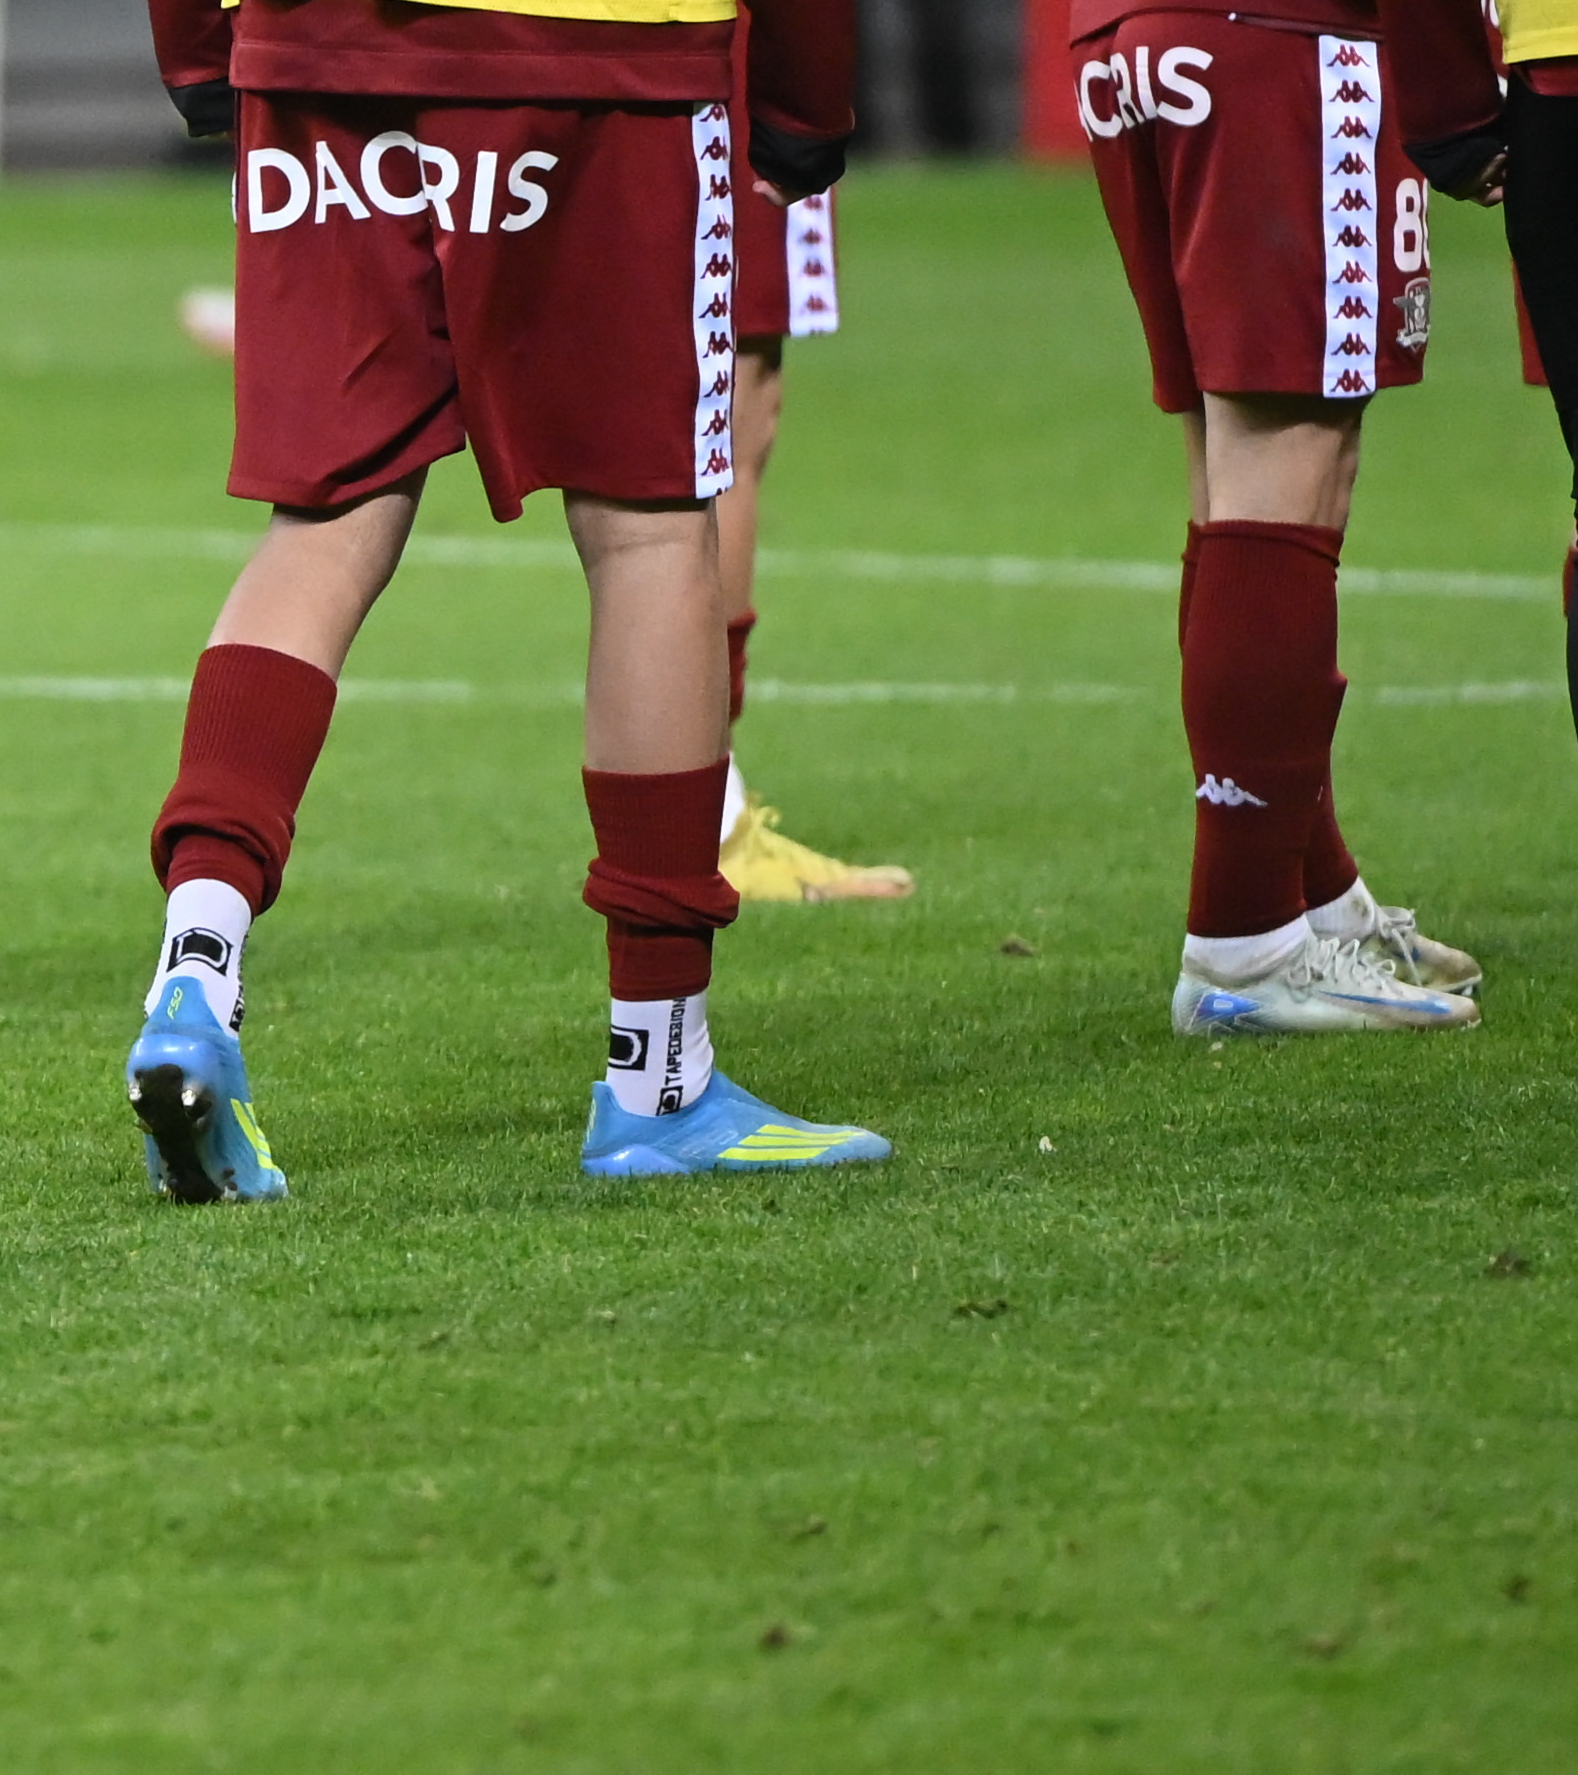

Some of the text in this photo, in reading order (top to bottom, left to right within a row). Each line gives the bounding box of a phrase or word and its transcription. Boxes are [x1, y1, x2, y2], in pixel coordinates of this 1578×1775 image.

[1073, 46, 1214, 142] CRIS
[247, 130, 560, 234] DACRIS
[1393, 177, 1430, 273] 8
